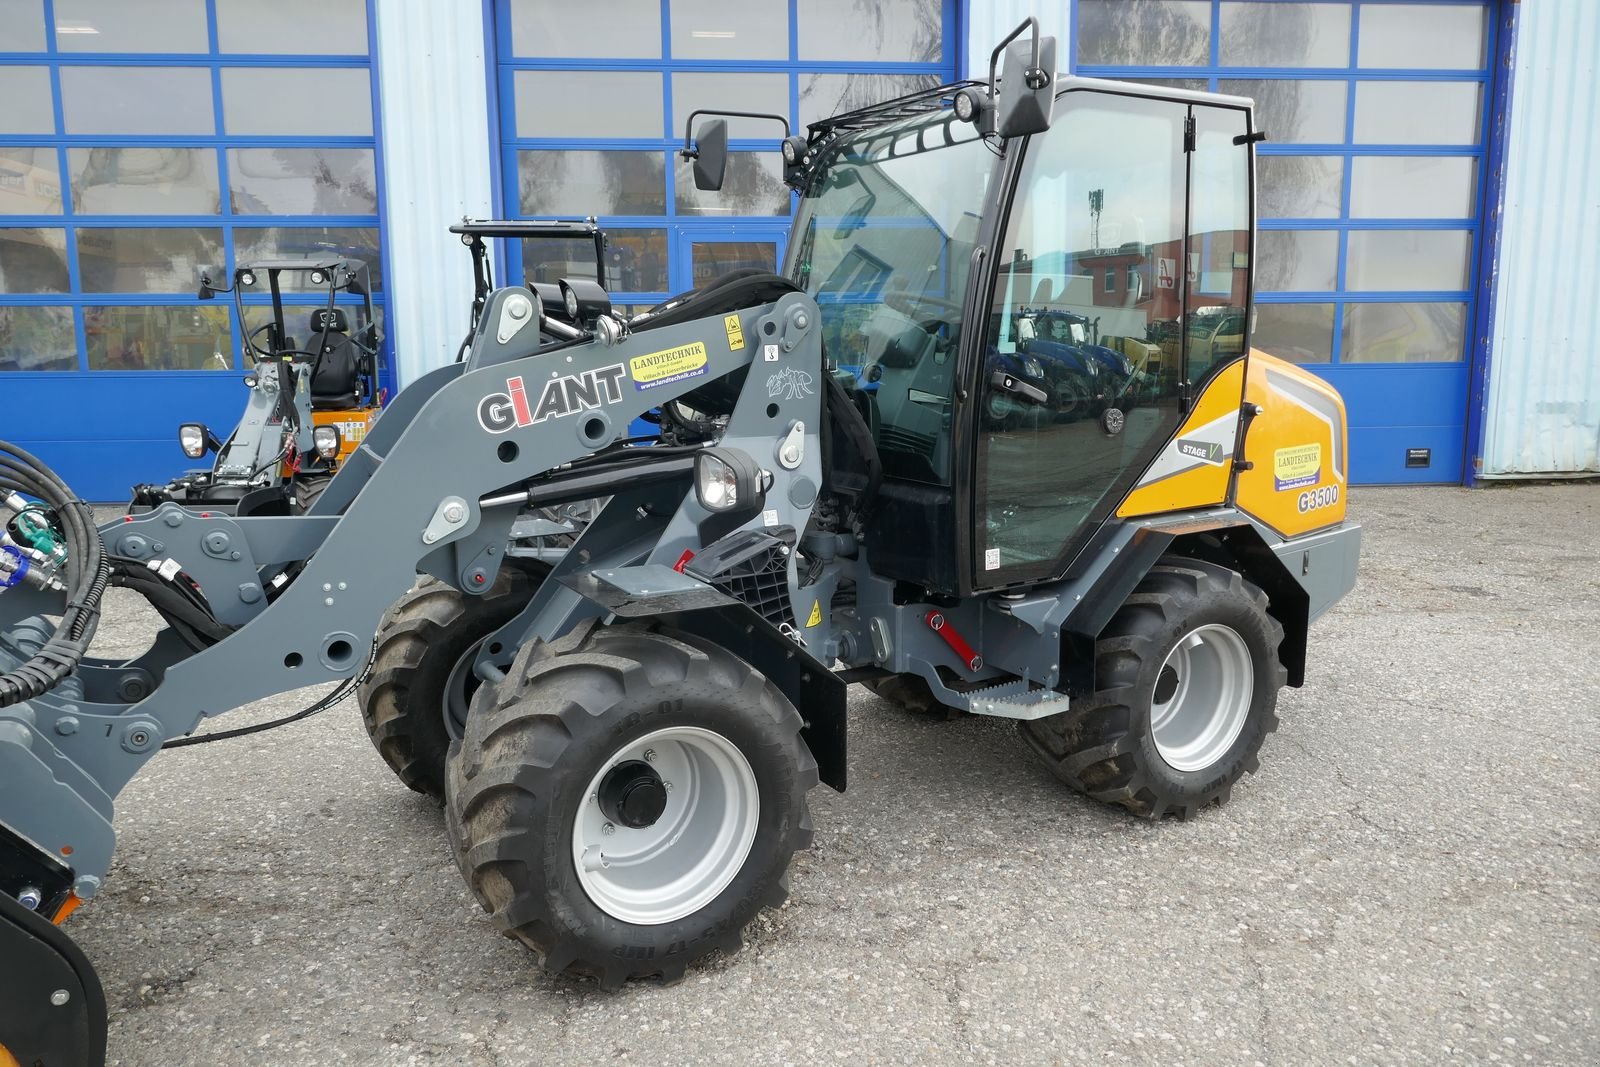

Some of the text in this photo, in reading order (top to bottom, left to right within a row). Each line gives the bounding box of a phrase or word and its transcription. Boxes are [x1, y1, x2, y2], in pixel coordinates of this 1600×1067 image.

[633, 345, 702, 370] LANDTECHNIK
[640, 368, 704, 390] www.landtechnik.co.at
[1182, 439, 1222, 459] STAGE V
[1278, 452, 1318, 468] LANDTECHNIK
[1297, 485, 1339, 514] G3500
